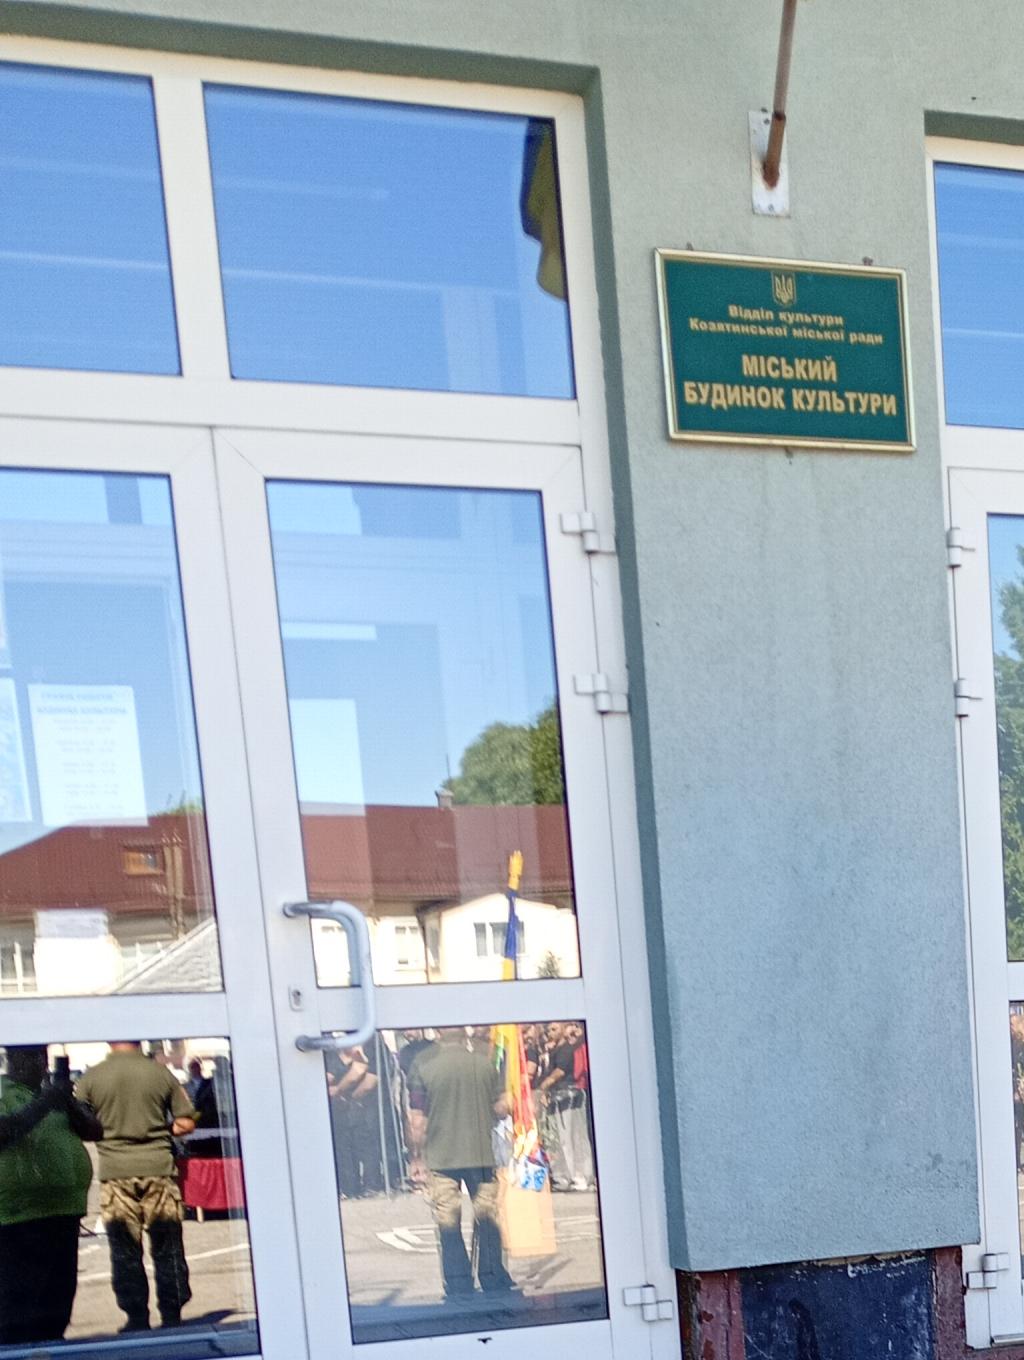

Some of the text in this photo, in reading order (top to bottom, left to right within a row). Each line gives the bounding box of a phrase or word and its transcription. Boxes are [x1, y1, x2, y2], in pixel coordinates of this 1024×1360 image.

[779, 309, 843, 327] культури
[792, 328, 844, 342] міської
[849, 332, 883, 344] ради
[742, 355, 837, 381] МІСЬКИЙ
[683, 382, 896, 416] БУДИНОК КУЛЬТУРИ
